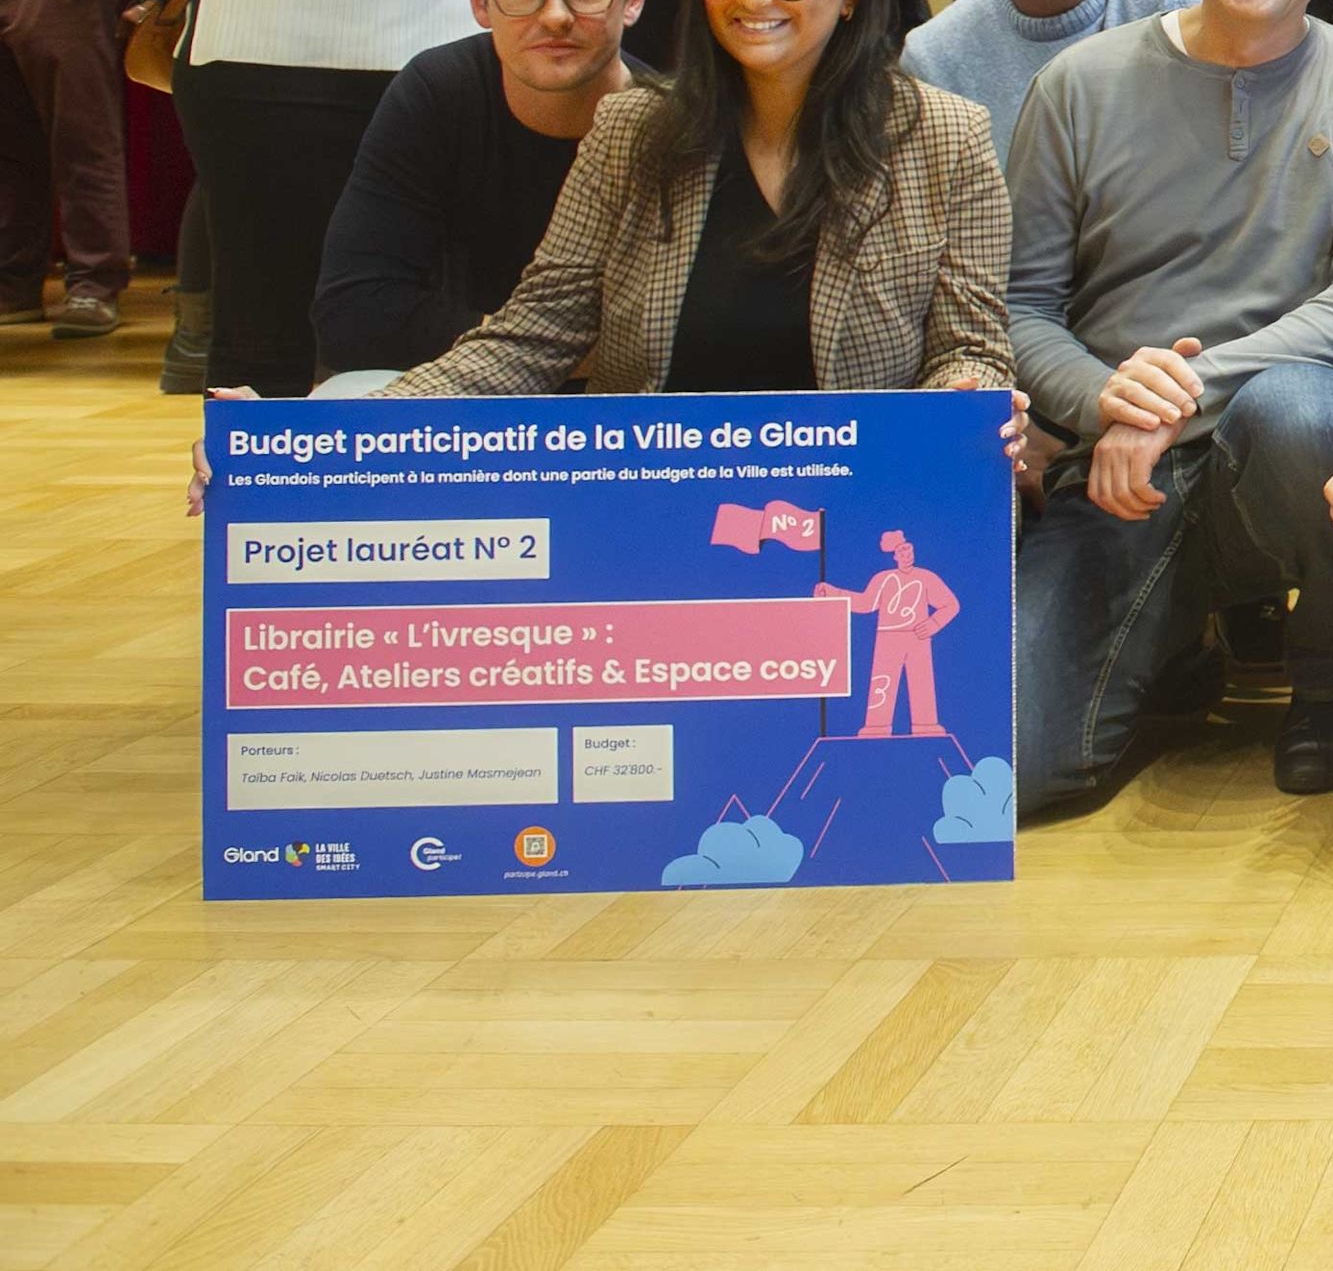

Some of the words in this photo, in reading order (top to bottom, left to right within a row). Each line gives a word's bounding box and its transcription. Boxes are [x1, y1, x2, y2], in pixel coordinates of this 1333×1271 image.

[229, 428, 347, 463] Budget
[354, 423, 538, 462] participatif
[544, 424, 587, 451] de
[594, 423, 624, 450] la
[631, 421, 703, 449] Ville
[709, 421, 752, 448] de
[758, 419, 857, 447] Gland
[228, 473, 252, 486] Les
[253, 471, 320, 485] Glandois
[322, 470, 405, 488] participent
[406, 469, 418, 483] à
[420, 470, 435, 483] la
[437, 468, 500, 483] manière
[501, 468, 538, 482] dont
[539, 470, 569, 481] une
[570, 466, 616, 484] partie
[617, 466, 638, 480] du
[640, 466, 695, 483] budget
[696, 465, 717, 479] de
[718, 465, 734, 478] la
[735, 464, 768, 478] Ville
[769, 464, 794, 477] est
[795, 462, 853, 477] utilisée.
[244, 536, 337, 571] Projet
[346, 534, 464, 562] lauréat
[519, 534, 536, 559] 2
[244, 621, 375, 650] Librairie
[407, 620, 573, 653] L’ivresque
[243, 662, 328, 693] Café,
[337, 660, 461, 689] Ateliers
[468, 657, 593, 687] créatifs
[601, 658, 626, 684] &
[634, 658, 752, 691] Espace
[758, 657, 837, 687] cosy
[309, 770, 357, 782] Nicolas
[417, 769, 463, 780] Justine
[466, 768, 541, 781] Masmejean
[223, 846, 279, 863] Gland
